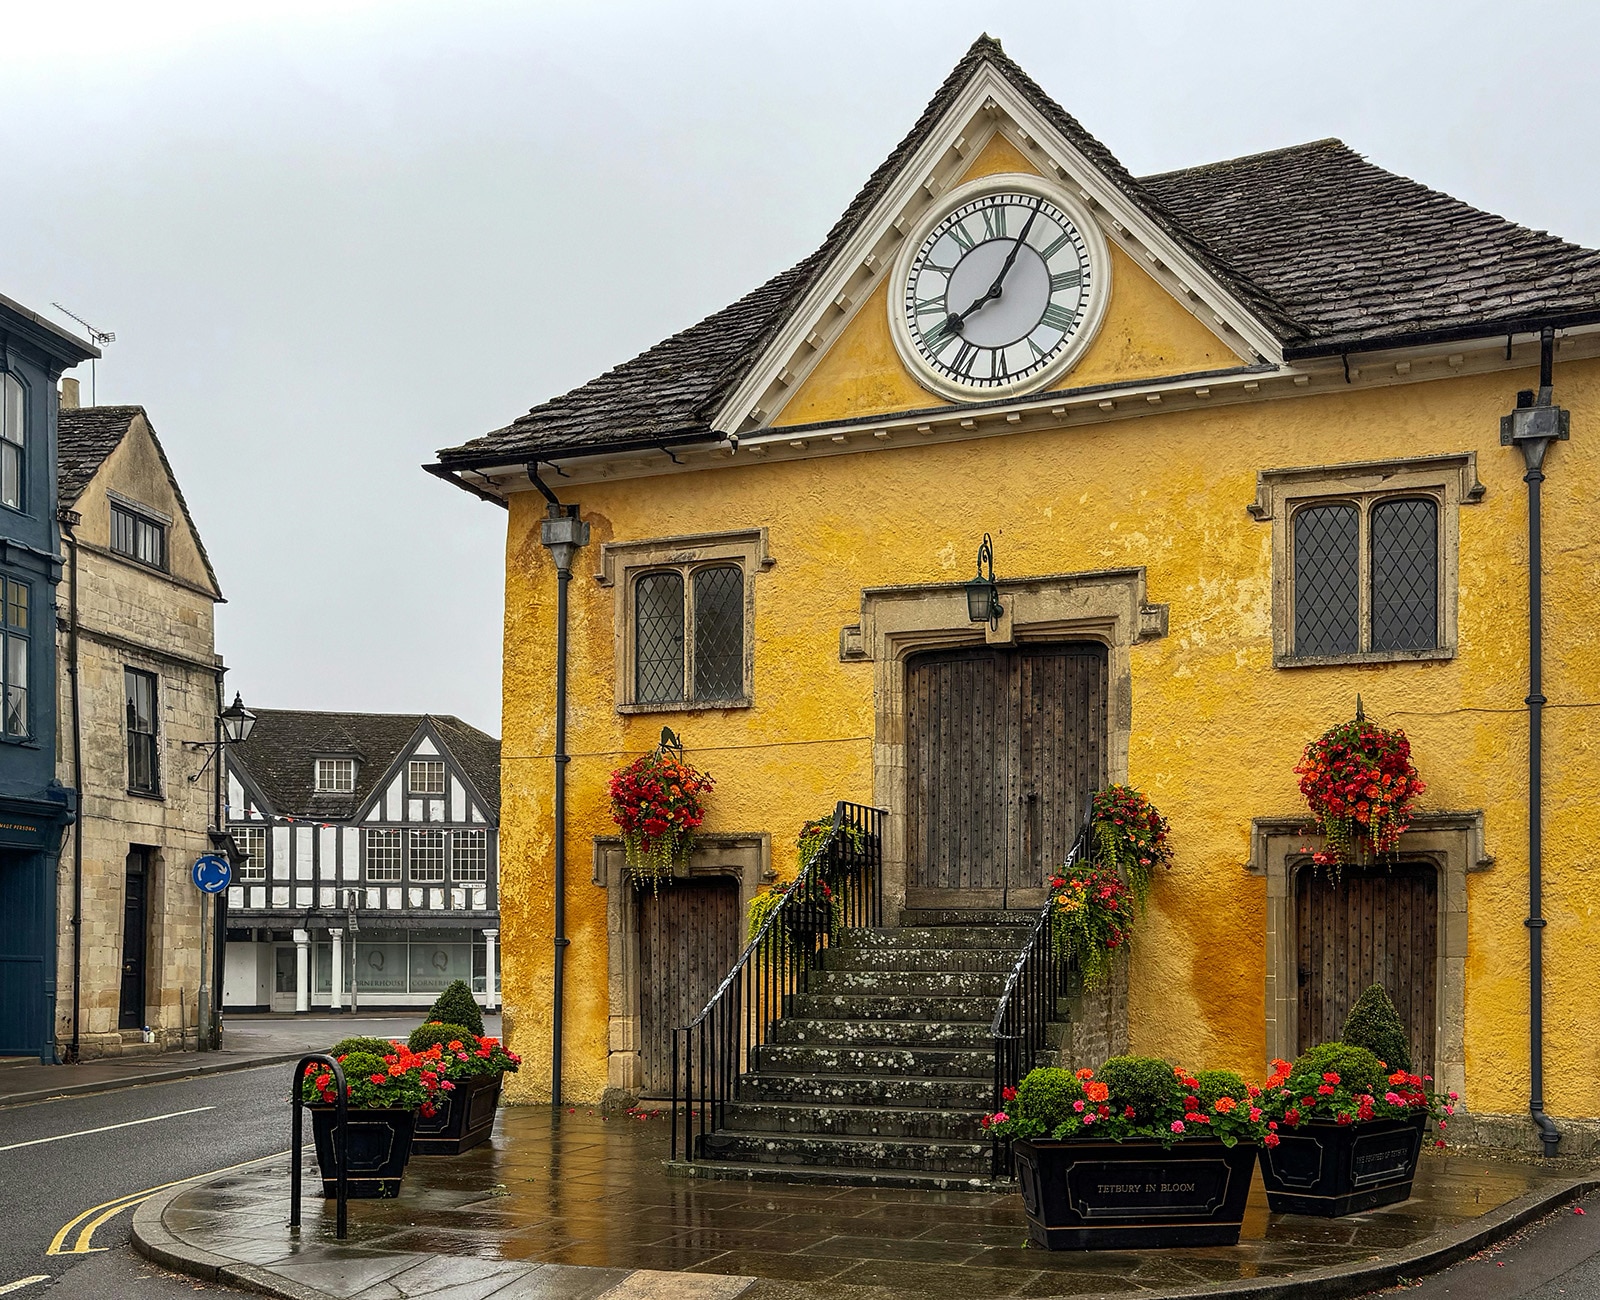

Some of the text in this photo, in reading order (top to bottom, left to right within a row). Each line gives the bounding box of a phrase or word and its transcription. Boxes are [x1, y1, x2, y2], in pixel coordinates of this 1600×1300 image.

[368, 950, 384, 971] Q
[431, 950, 449, 972] Q
[1097, 1182, 1195, 1194] TETBURY IN BLOOM
